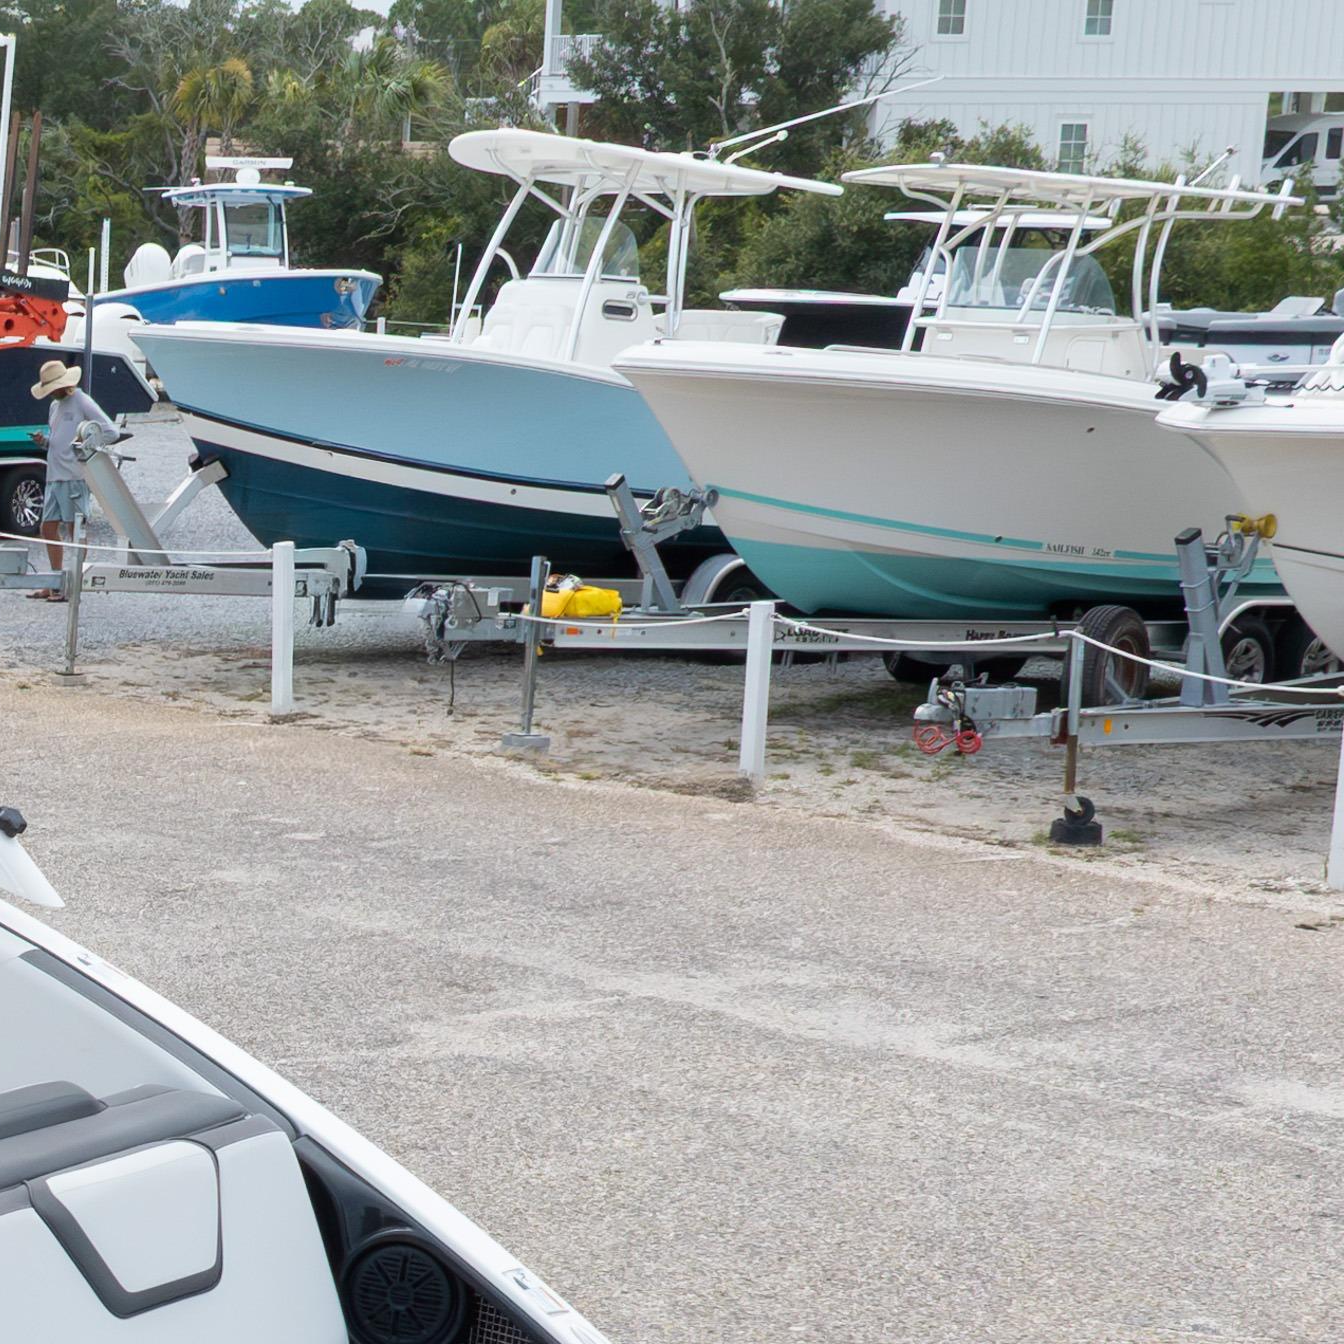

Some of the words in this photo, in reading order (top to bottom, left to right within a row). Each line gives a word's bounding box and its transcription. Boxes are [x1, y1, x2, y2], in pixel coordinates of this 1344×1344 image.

[118, 568, 162, 579] Bluewater
[165, 569, 189, 580] Yacht
[191, 570, 214, 580] Sales
